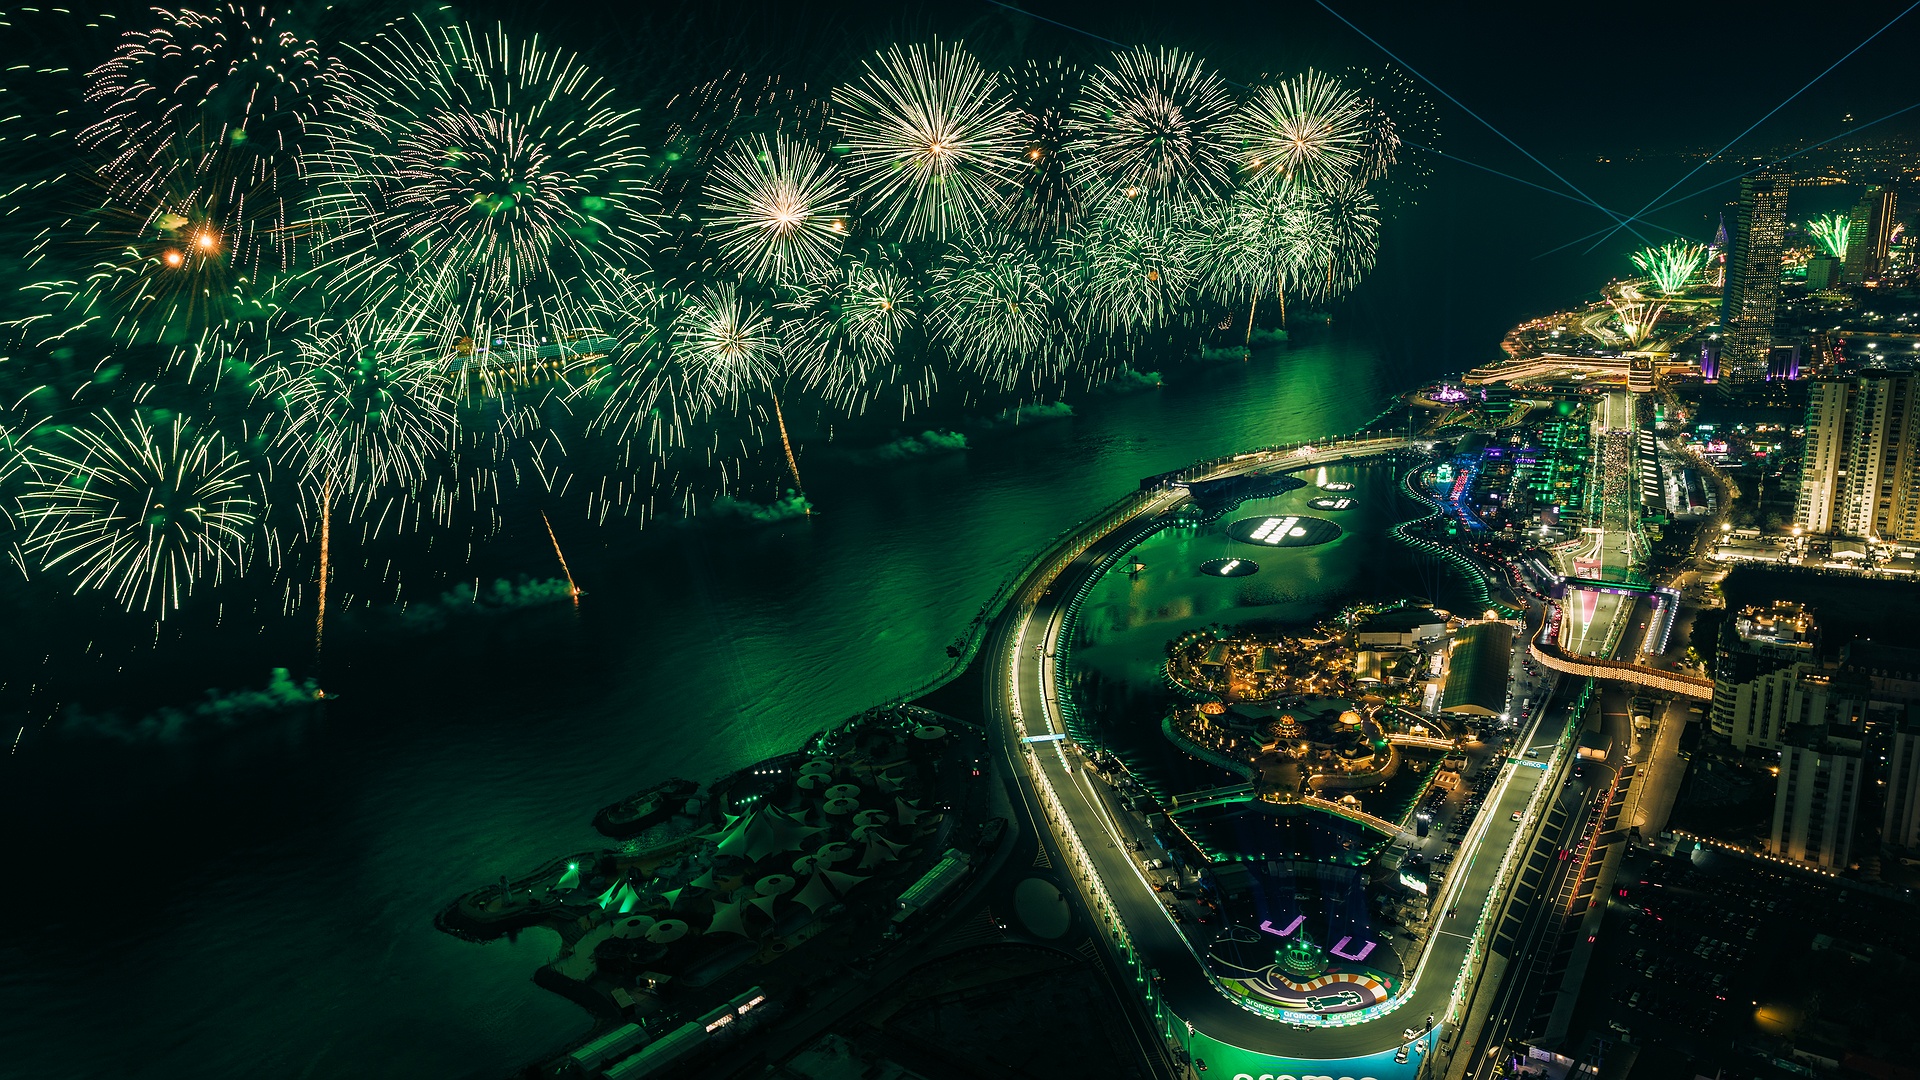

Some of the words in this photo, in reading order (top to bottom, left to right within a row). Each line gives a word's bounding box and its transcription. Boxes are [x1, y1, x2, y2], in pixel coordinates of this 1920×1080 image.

[1515, 760, 1541, 768] aramco
[1245, 998, 1275, 1013] aramco
[1371, 997, 1395, 1013] aramco
[1284, 1010, 1317, 1020] aramco
[1332, 1010, 1362, 1021] aramco
